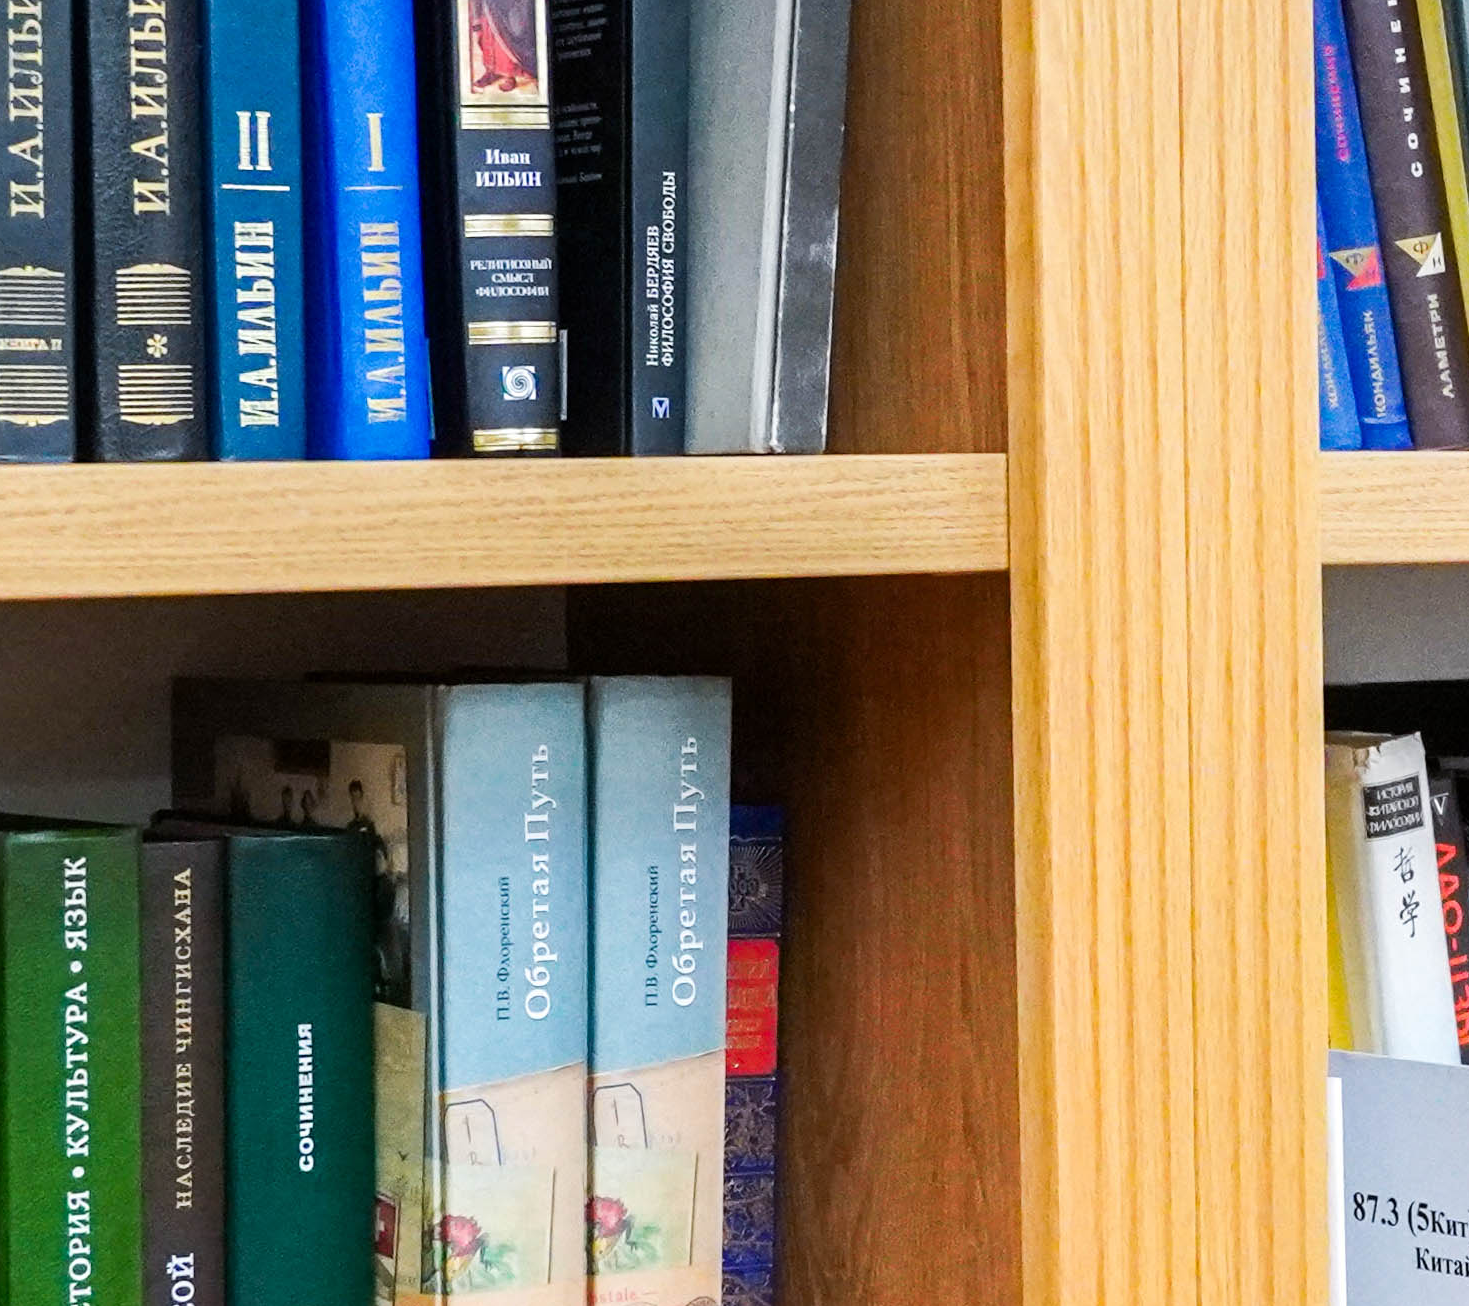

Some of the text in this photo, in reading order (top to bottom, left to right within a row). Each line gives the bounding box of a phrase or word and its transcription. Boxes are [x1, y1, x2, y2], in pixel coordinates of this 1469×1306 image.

[475, 171, 542, 188] ИЛЬИН
[486, 149, 530, 166] Иван
[645, 224, 661, 305] БЕРДЯЕВ
[659, 171, 677, 369] ФИЛОСОФИЯ СВОБОДЫ
[1426, 292, 1455, 399] ЛАМЕТРИ
[61, 857, 88, 951] ЯЗЫК
[522, 744, 554, 1022] Обретая Путь
[671, 736, 701, 1008] Обретая Путь
[1392, 847, 1421, 938] 哲学
[173, 867, 193, 1056] ЧИНГИСХАНА
[64, 982, 91, 1159] КУЛЬТУРА
[297, 1022, 315, 1174] СОЧИНЕНИЯ
[175, 1066, 195, 1210] НАСЛЕДИЕ
[1351, 1191, 1401, 1227] 87.3
